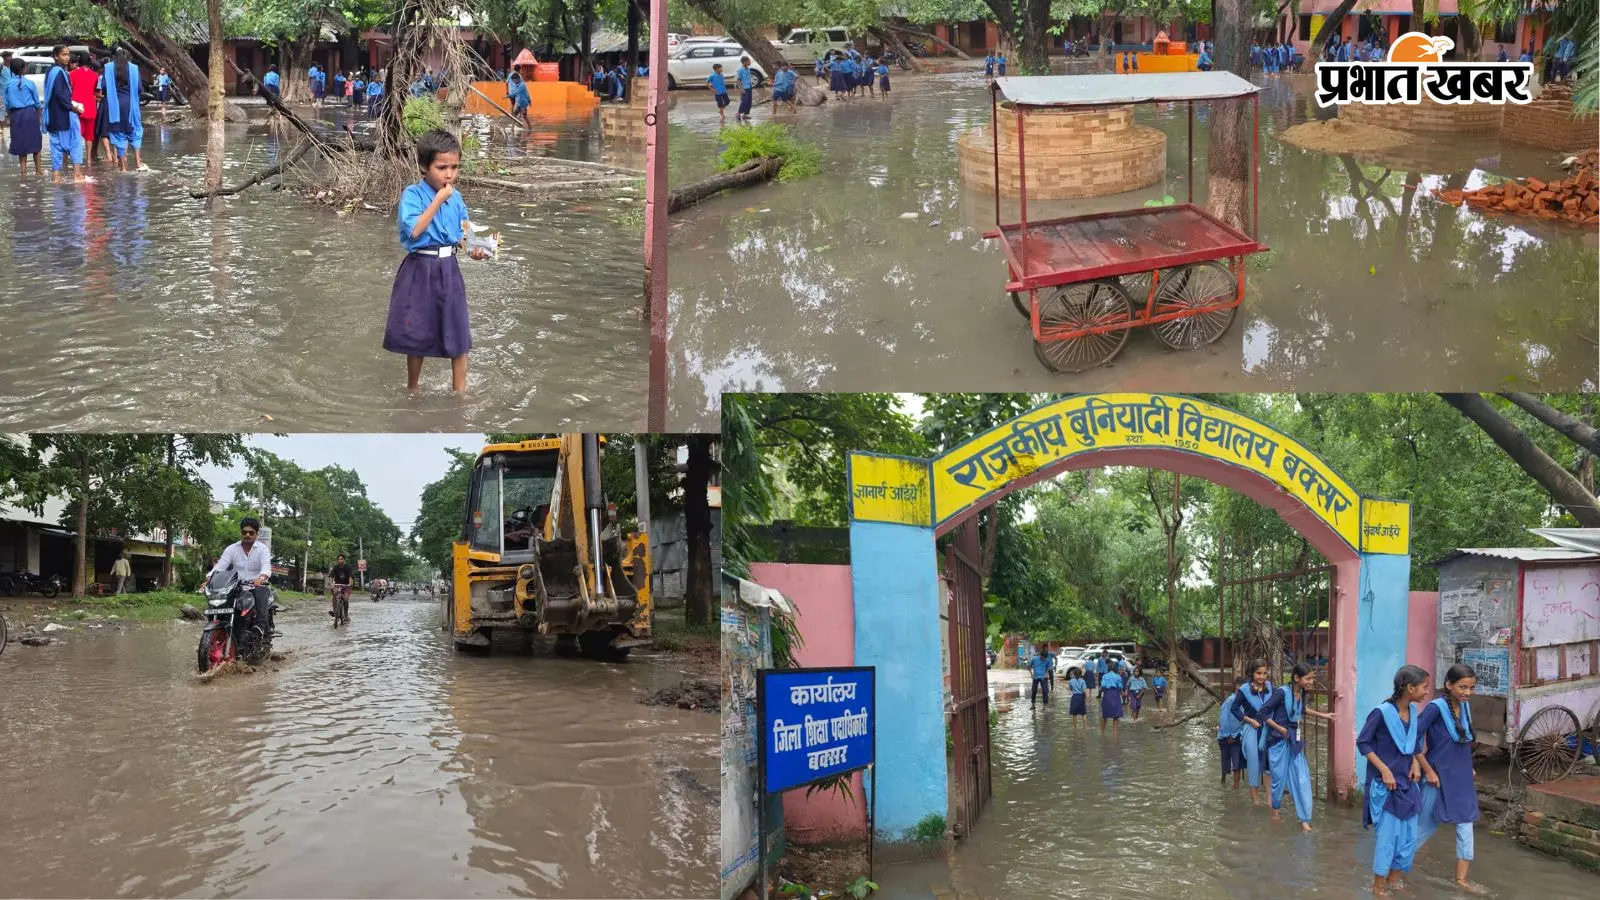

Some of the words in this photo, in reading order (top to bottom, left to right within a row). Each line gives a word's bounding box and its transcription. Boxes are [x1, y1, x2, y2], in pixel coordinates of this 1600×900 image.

[1174, 439, 1199, 450] 1950
[946, 414, 1067, 489] राजकीय
[1067, 397, 1173, 447] बुनियादी
[1177, 402, 1279, 468] विद्यालय
[1282, 449, 1353, 525] बक्सर
[789, 676, 857, 706] कार्यालय
[773, 719, 802, 753] जिला
[805, 714, 829, 747] शिक्षा
[831, 706, 868, 741] पदाधिकारी
[807, 745, 848, 770] बक्सर
